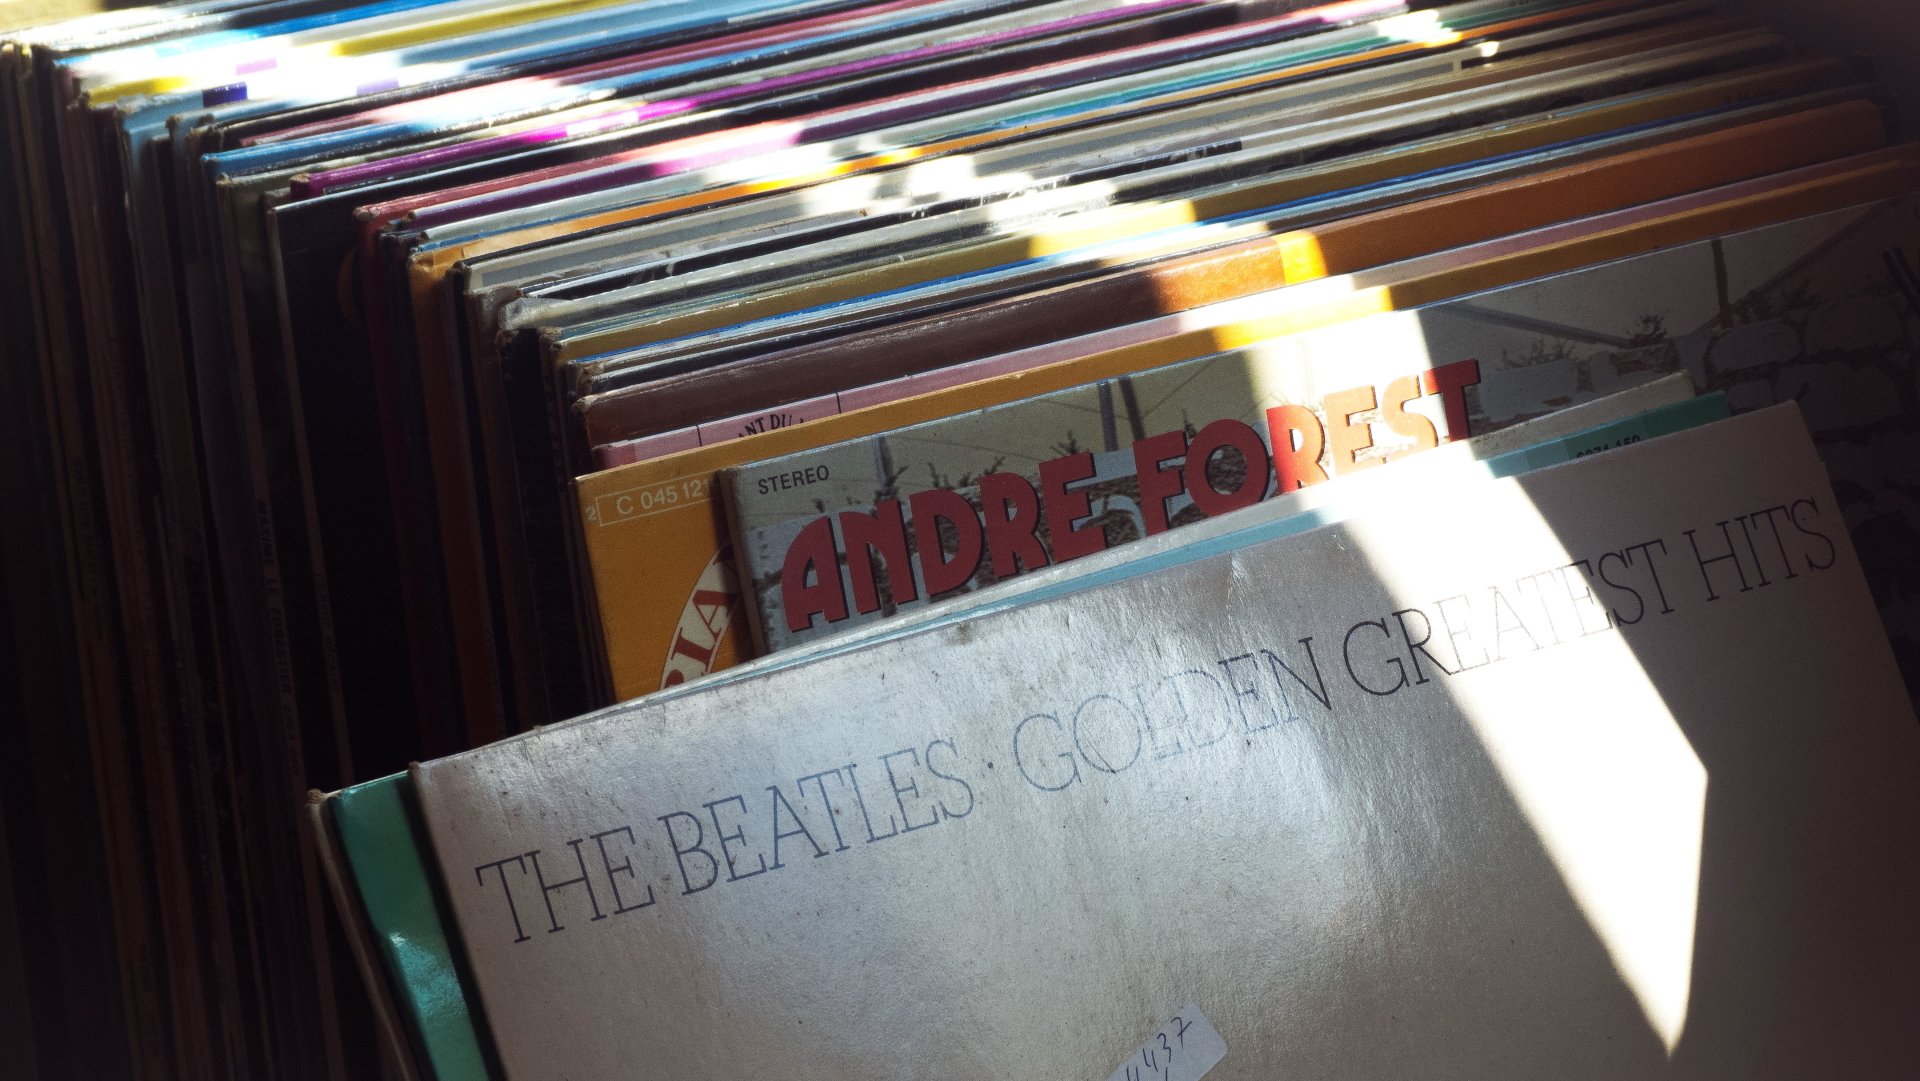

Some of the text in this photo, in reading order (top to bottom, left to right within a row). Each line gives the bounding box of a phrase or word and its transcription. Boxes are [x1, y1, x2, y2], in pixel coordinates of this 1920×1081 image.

[615, 495, 634, 515] C
[640, 486, 678, 510] 045
[758, 465, 830, 495] STEREO
[780, 358, 1481, 634] ANDRE FOREST
[474, 496, 1838, 943] THE BEATLES GOLDEN GREATEST HITS
